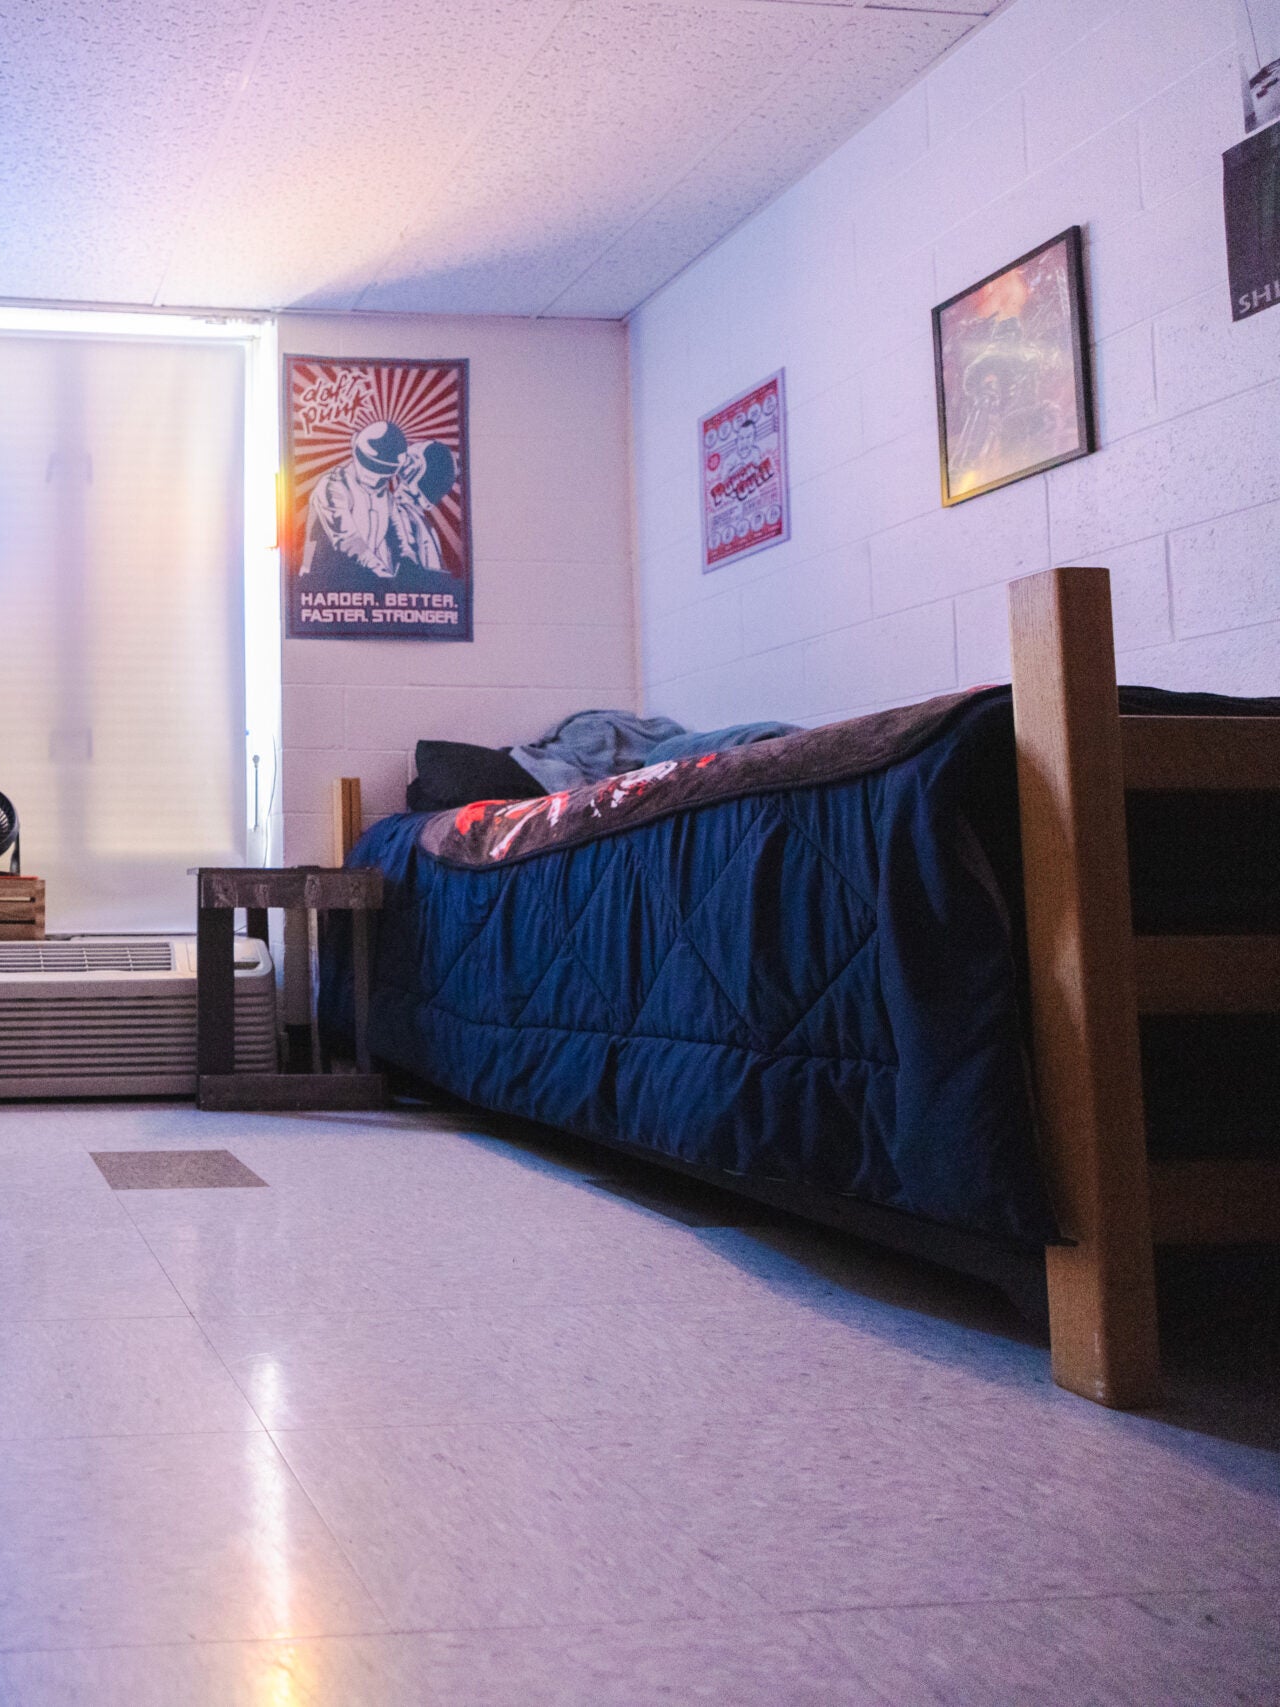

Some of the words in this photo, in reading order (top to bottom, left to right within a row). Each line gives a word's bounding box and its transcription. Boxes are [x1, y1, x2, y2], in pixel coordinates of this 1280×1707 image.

[300, 592, 380, 607] HARDER.
[384, 593, 459, 608] BETTER.
[300, 609, 369, 623] FASTER.
[371, 608, 459, 625] STRONGER!
